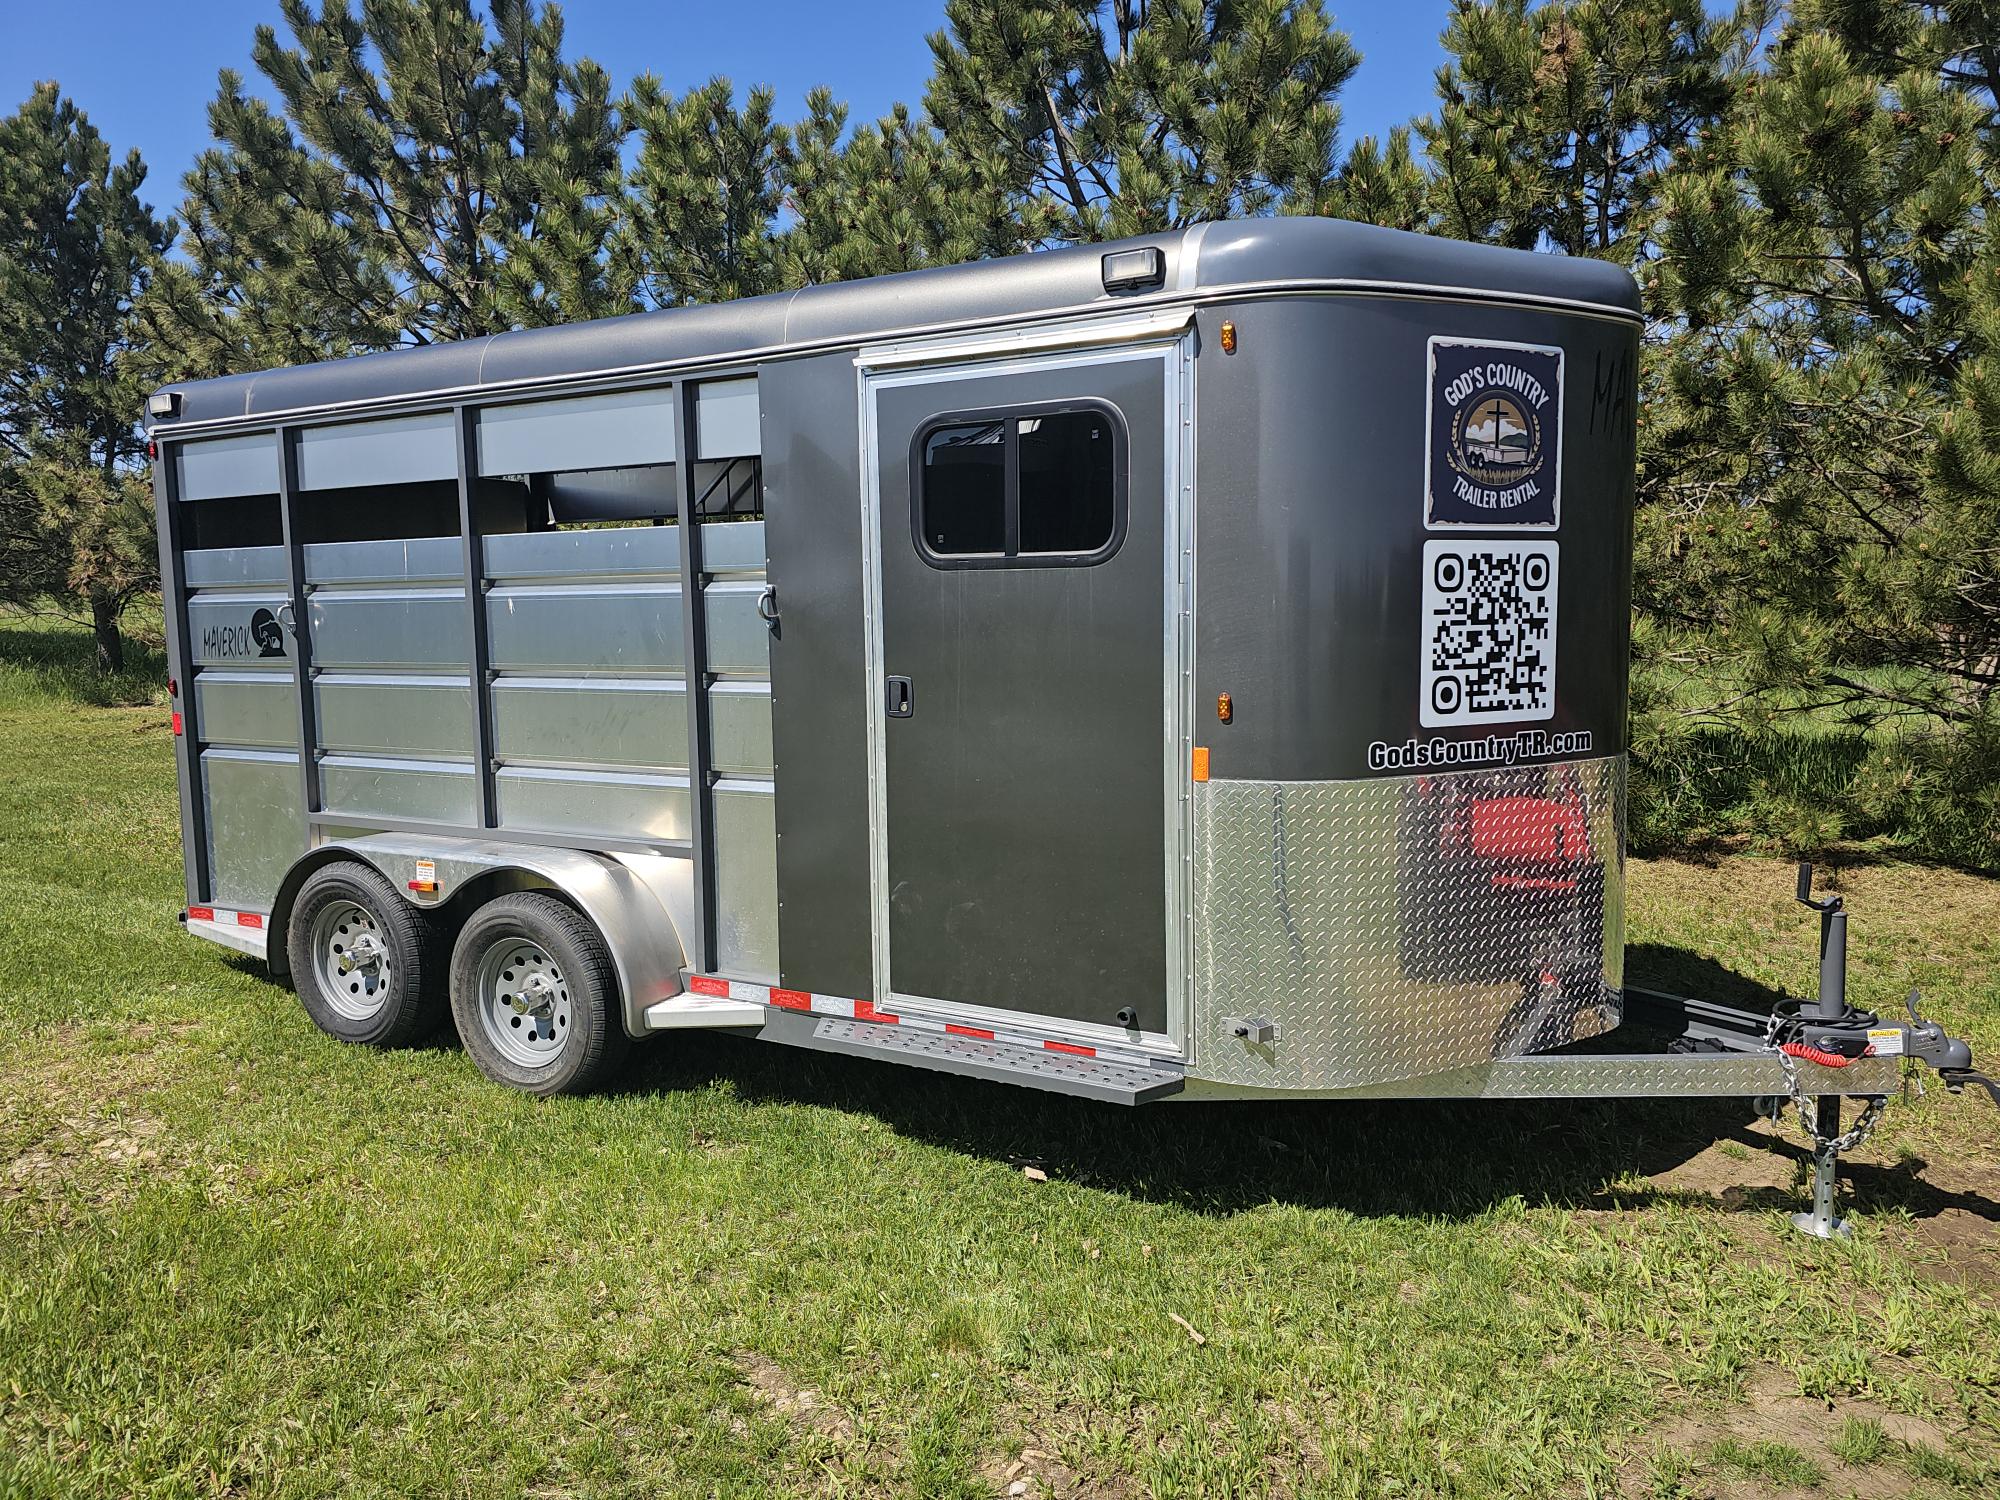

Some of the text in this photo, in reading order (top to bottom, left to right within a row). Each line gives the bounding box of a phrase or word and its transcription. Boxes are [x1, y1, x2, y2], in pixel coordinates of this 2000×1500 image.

[1444, 363, 1550, 411] GOD'S COUNTRY
[1589, 347, 1633, 443] MA
[1452, 475, 1541, 509] TRAILER RENTAL
[203, 625, 251, 659] MAVERICK
[1368, 729, 1592, 770] GodsCountryTR.com
